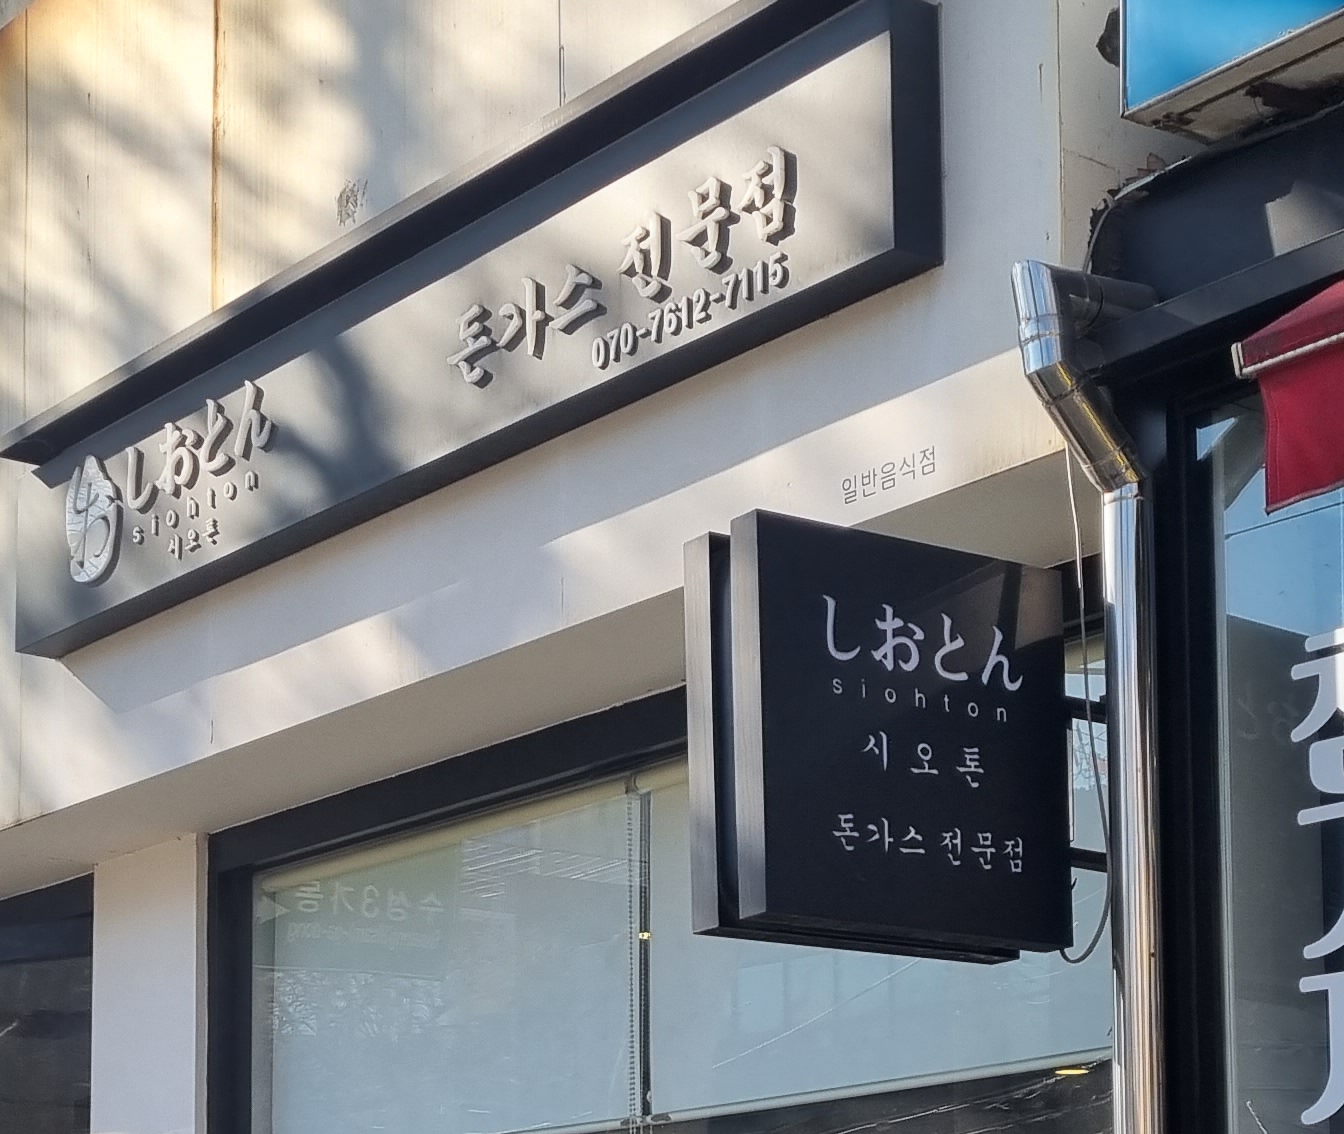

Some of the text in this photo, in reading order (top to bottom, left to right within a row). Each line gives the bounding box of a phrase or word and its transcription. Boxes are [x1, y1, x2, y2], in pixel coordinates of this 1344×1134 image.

[447, 145, 797, 388] 돈가스 전문점
[592, 252, 790, 369] 070-7612-7115
[125, 379, 274, 512] しおとん
[840, 445, 937, 504] 일반음식점
[822, 594, 1024, 692] しおとん
[832, 675, 1008, 723] siohton
[862, 731, 985, 788] 시오톤
[832, 813, 1024, 873] 돈가스 전문점
